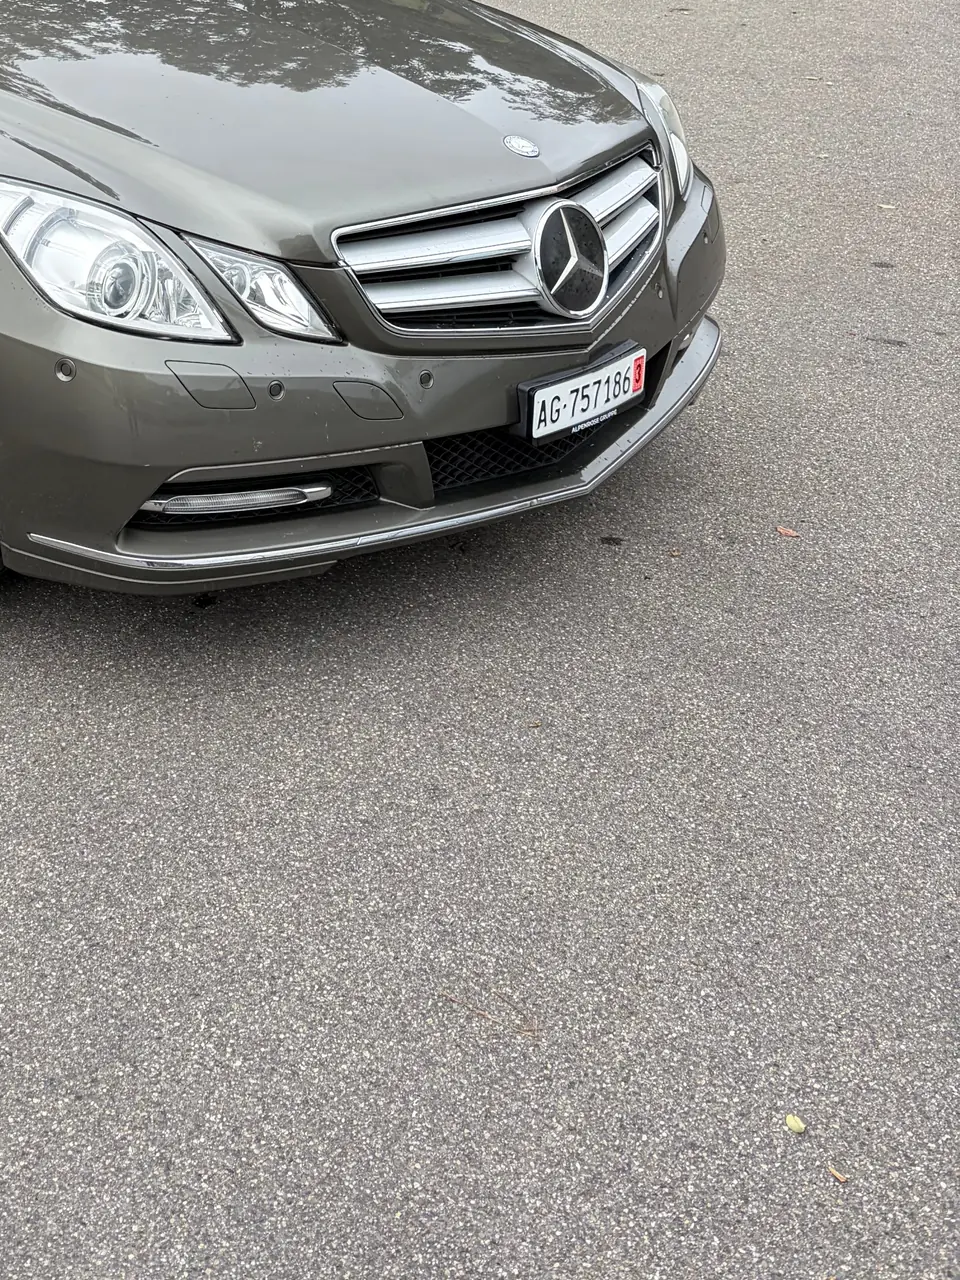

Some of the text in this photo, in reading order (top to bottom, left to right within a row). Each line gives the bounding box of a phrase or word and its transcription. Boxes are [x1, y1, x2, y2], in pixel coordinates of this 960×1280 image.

[635, 363, 642, 384] 3
[571, 408, 618, 434] ALPENROSE GRUPPE
